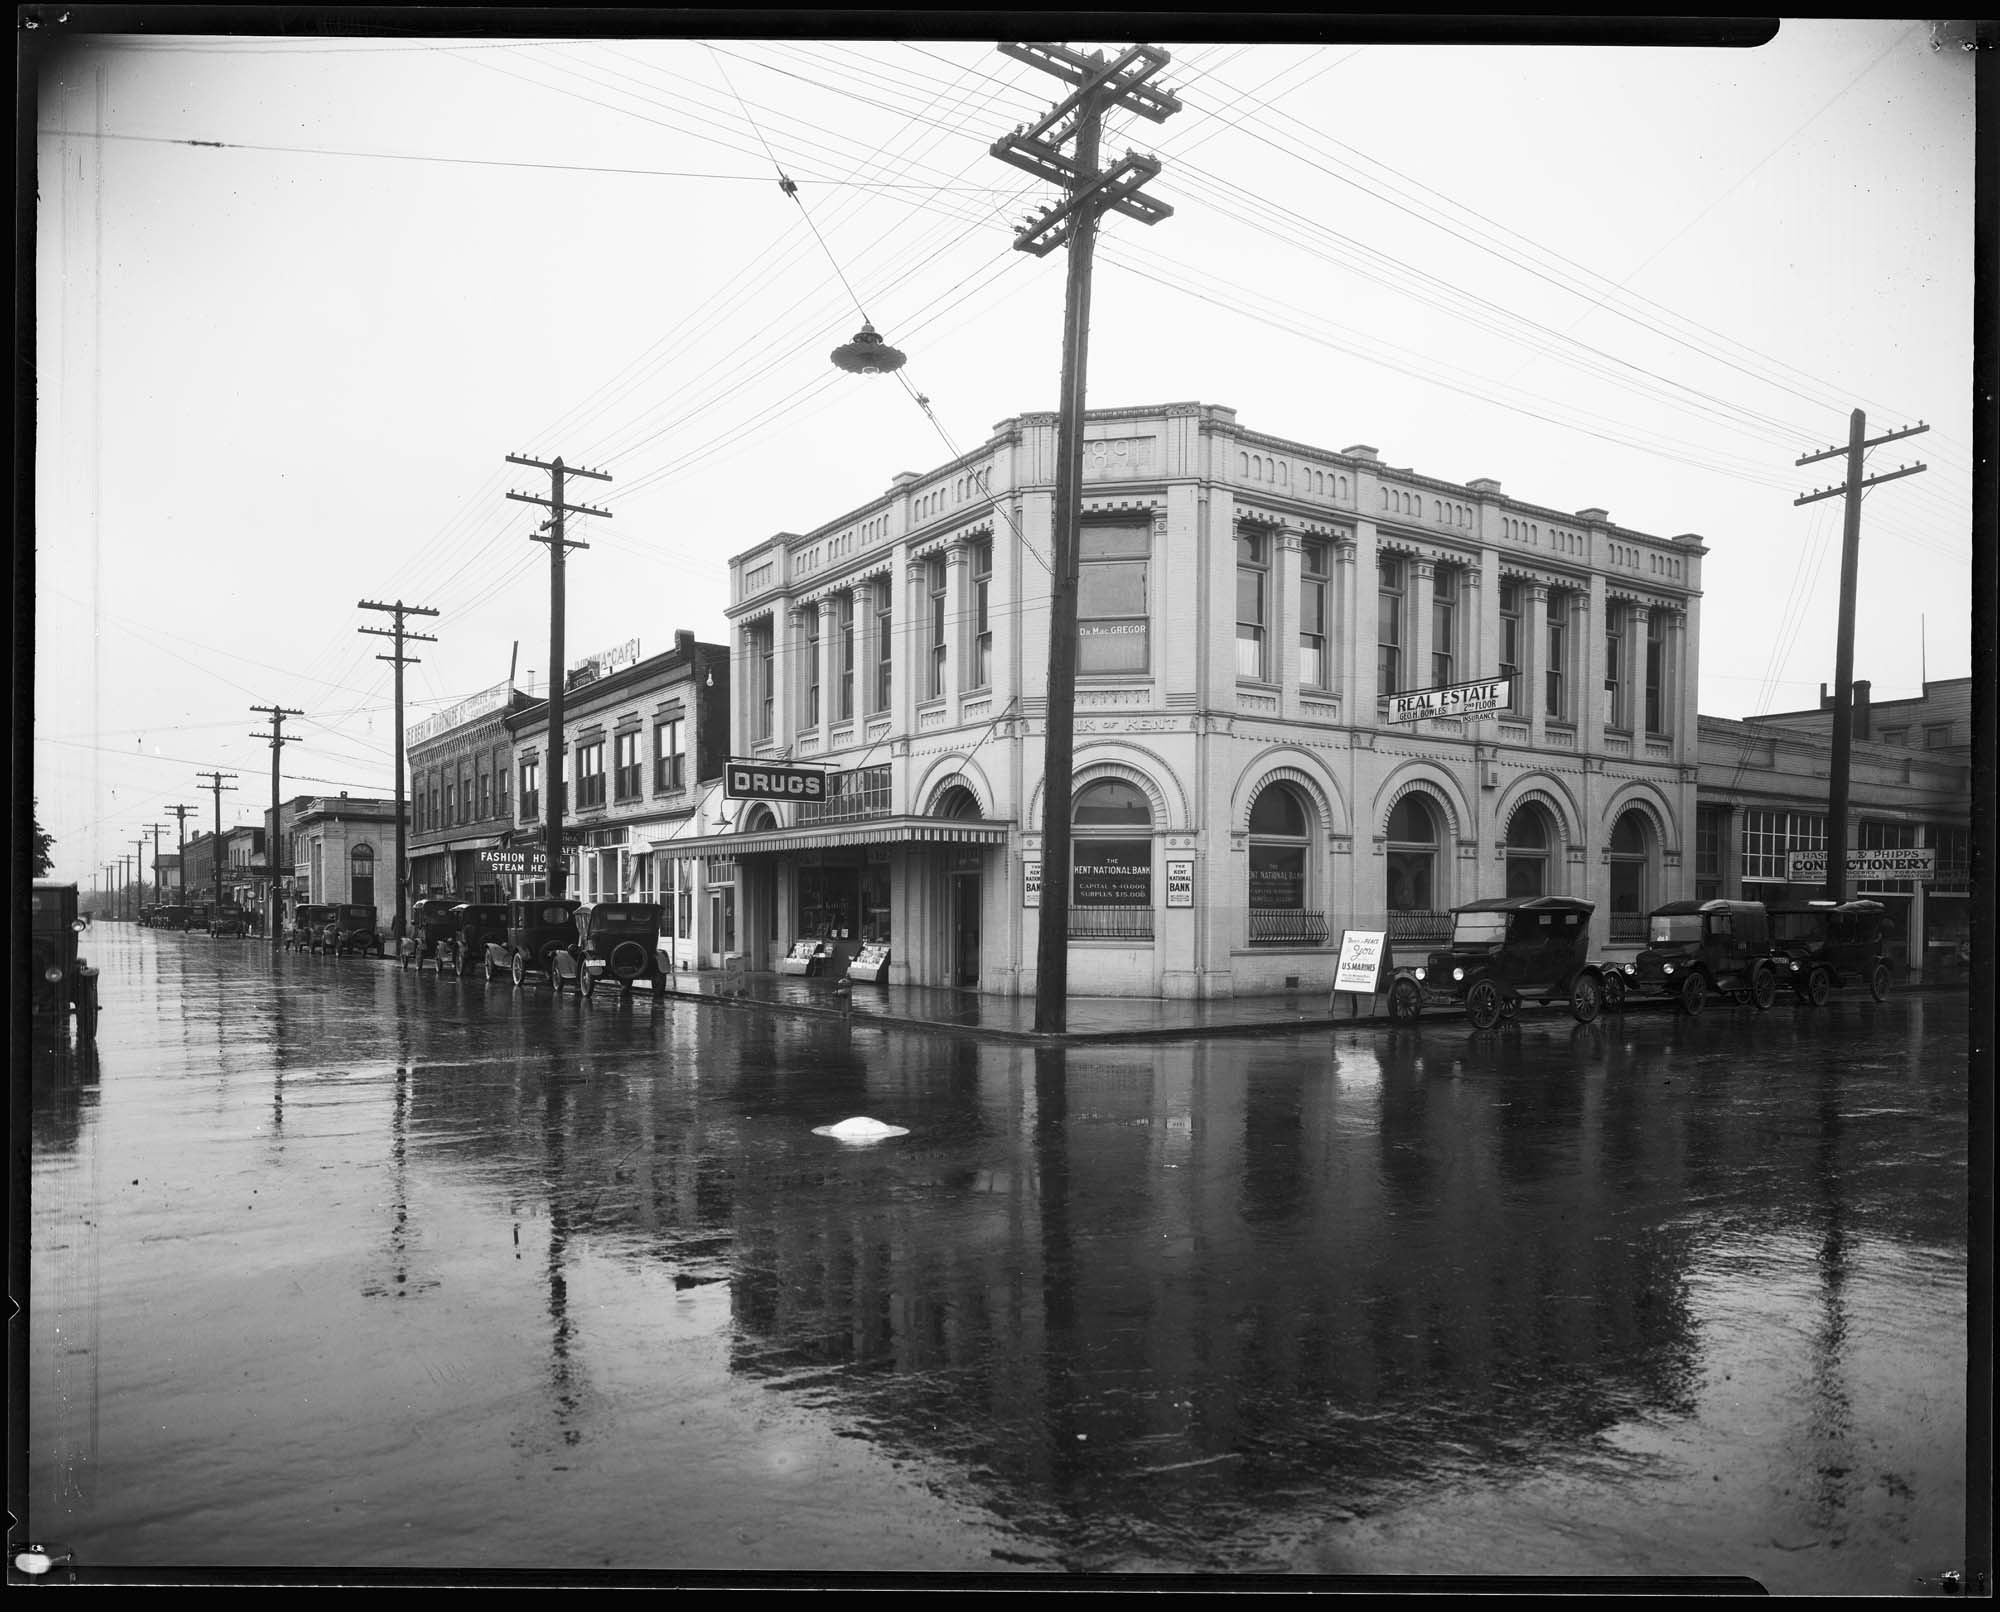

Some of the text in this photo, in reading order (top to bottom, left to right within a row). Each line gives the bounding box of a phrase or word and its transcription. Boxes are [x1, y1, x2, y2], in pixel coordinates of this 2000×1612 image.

[1397, 684, 1499, 713] REAL ESTATE
[1475, 699, 1497, 710] FLOOR
[1420, 706, 1447, 719] BOWLES
[1462, 711, 1497, 724] INSURANCE
[1125, 719, 1178, 731] KENT
[734, 771, 820, 794] DRUGS
[561, 847, 577, 855] AFE
[1874, 850, 1920, 859] PHIPPS
[481, 852, 525, 863] FASHION
[492, 864, 548, 873] STEAM HE
[1074, 866, 1151, 875] KENT NATIONAL BANK
[1792, 859, 1931, 871] CONCTIONERY
[1026, 882, 1041, 892] BAN
[1169, 882, 1190, 892] BANK
